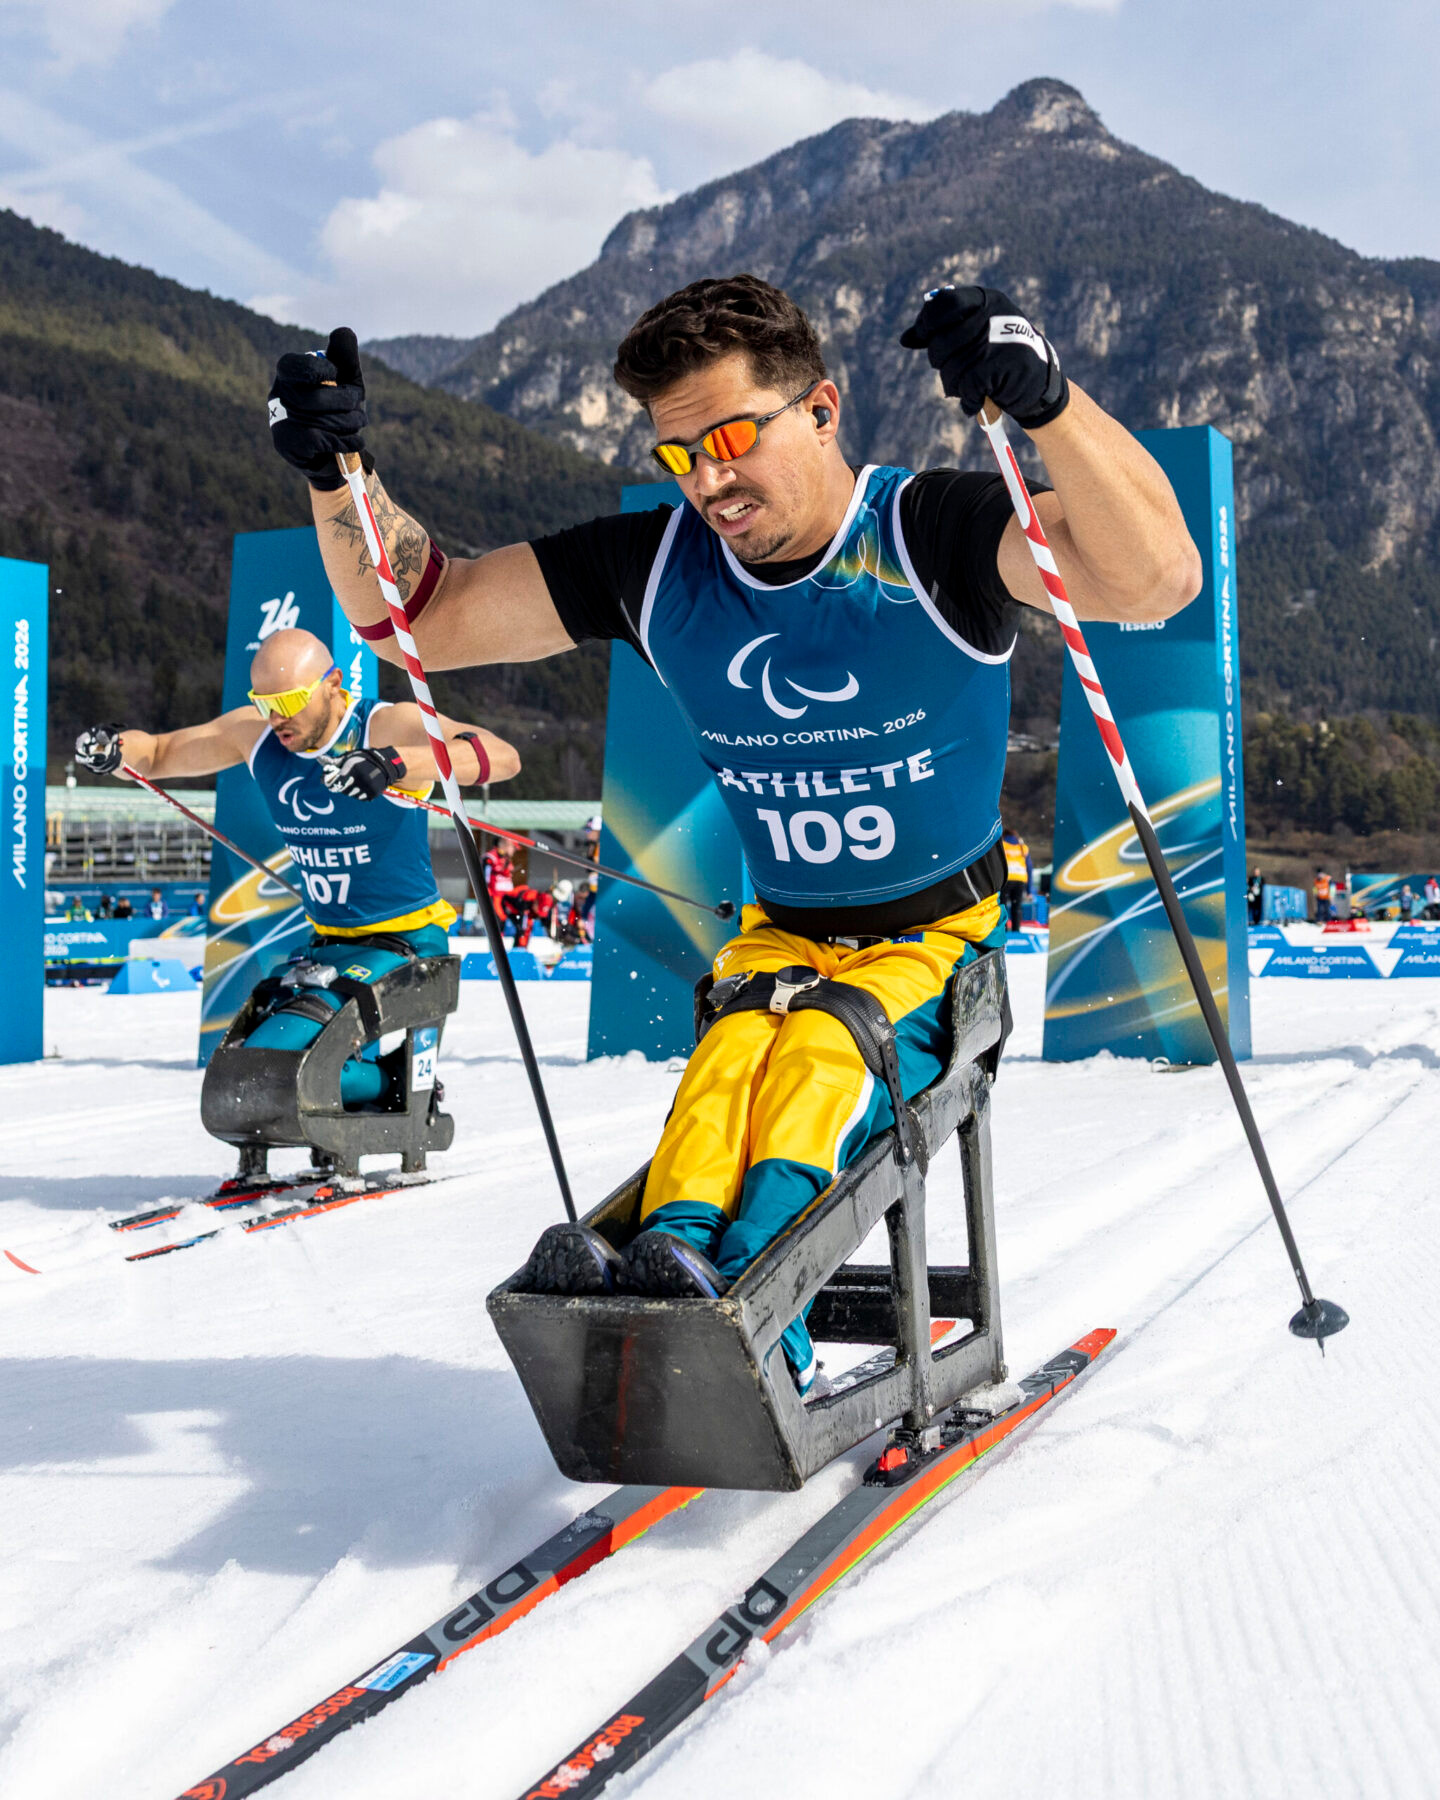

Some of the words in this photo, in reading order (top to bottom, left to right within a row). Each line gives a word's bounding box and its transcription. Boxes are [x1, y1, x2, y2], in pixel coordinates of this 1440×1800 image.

[14, 618, 30, 671] 2026
[1118, 619, 1166, 633] TESERO
[1221, 573, 1233, 706] CORTINA
[13, 674, 29, 782] CORTINA
[702, 728, 779, 747] MILANO
[782, 726, 879, 745] CORTINA
[883, 708, 927, 735] 2026
[717, 748, 936, 798] ATHLETE
[1226, 711, 1238, 842] MILANO
[13, 784, 27, 890] MILANO
[300, 827, 342, 836] CORTINA
[342, 823, 367, 835] 2026
[756, 804, 897, 865] 109
[301, 869, 351, 905] 107
[1271, 955, 1318, 965] MILANO
[1319, 955, 1367, 965] CORTINA
[1403, 954, 1440, 964] MILAN
[417, 1058, 433, 1078] 24
[234, 1686, 368, 1767] ROSSIGOL
[526, 1714, 646, 1800] ROSSIGOL
